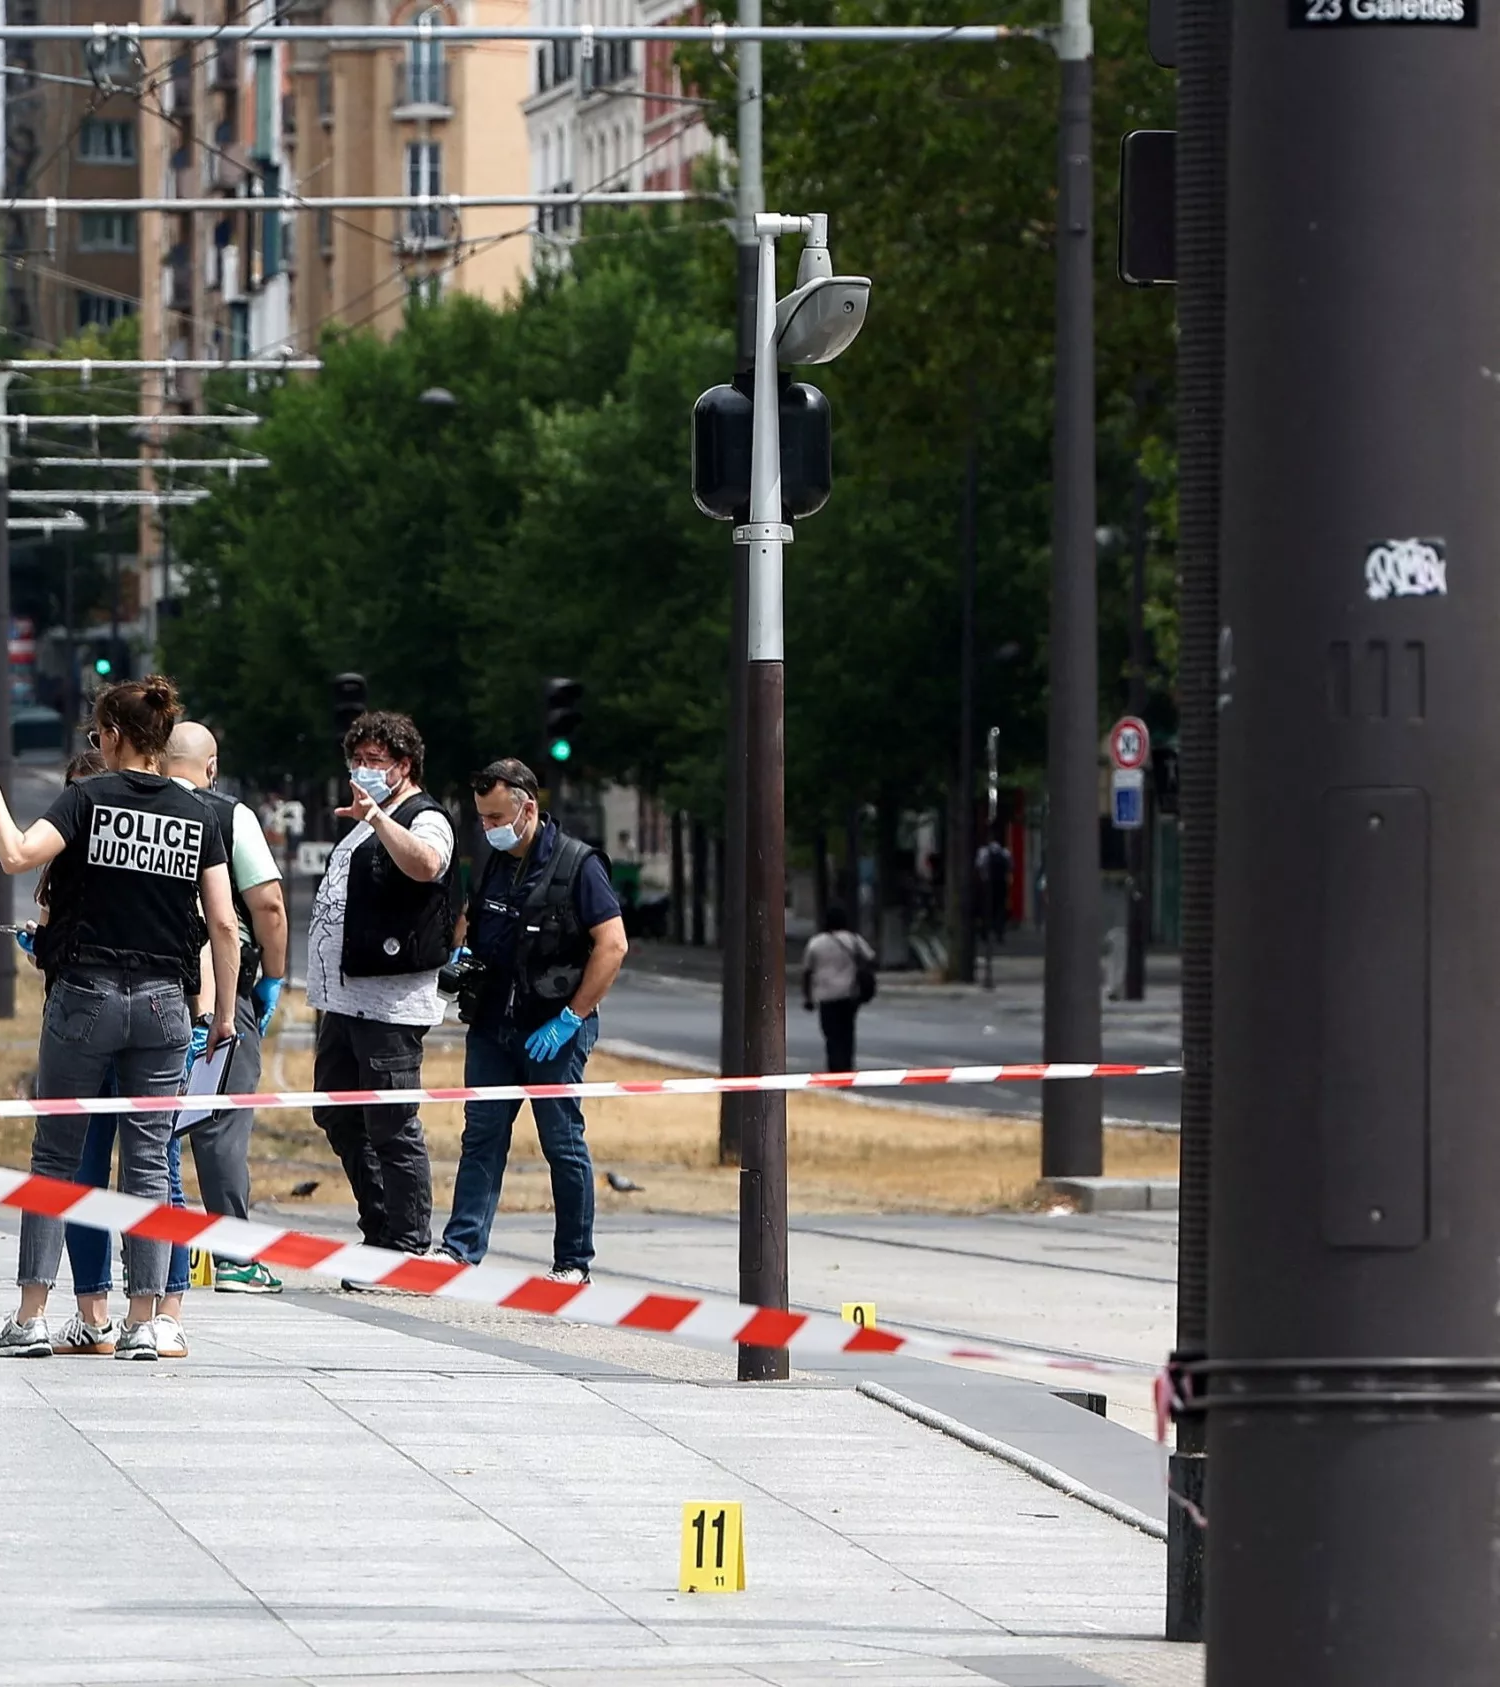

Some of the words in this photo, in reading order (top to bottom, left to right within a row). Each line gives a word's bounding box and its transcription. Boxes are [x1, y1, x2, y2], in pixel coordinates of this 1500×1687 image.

[1305, 0, 1343, 21] 23
[93, 808, 201, 853] POLICE
[90, 839, 198, 879] JUDICIAIRE
[692, 1510, 726, 1569] 11
[714, 1576, 725, 1587] 11
